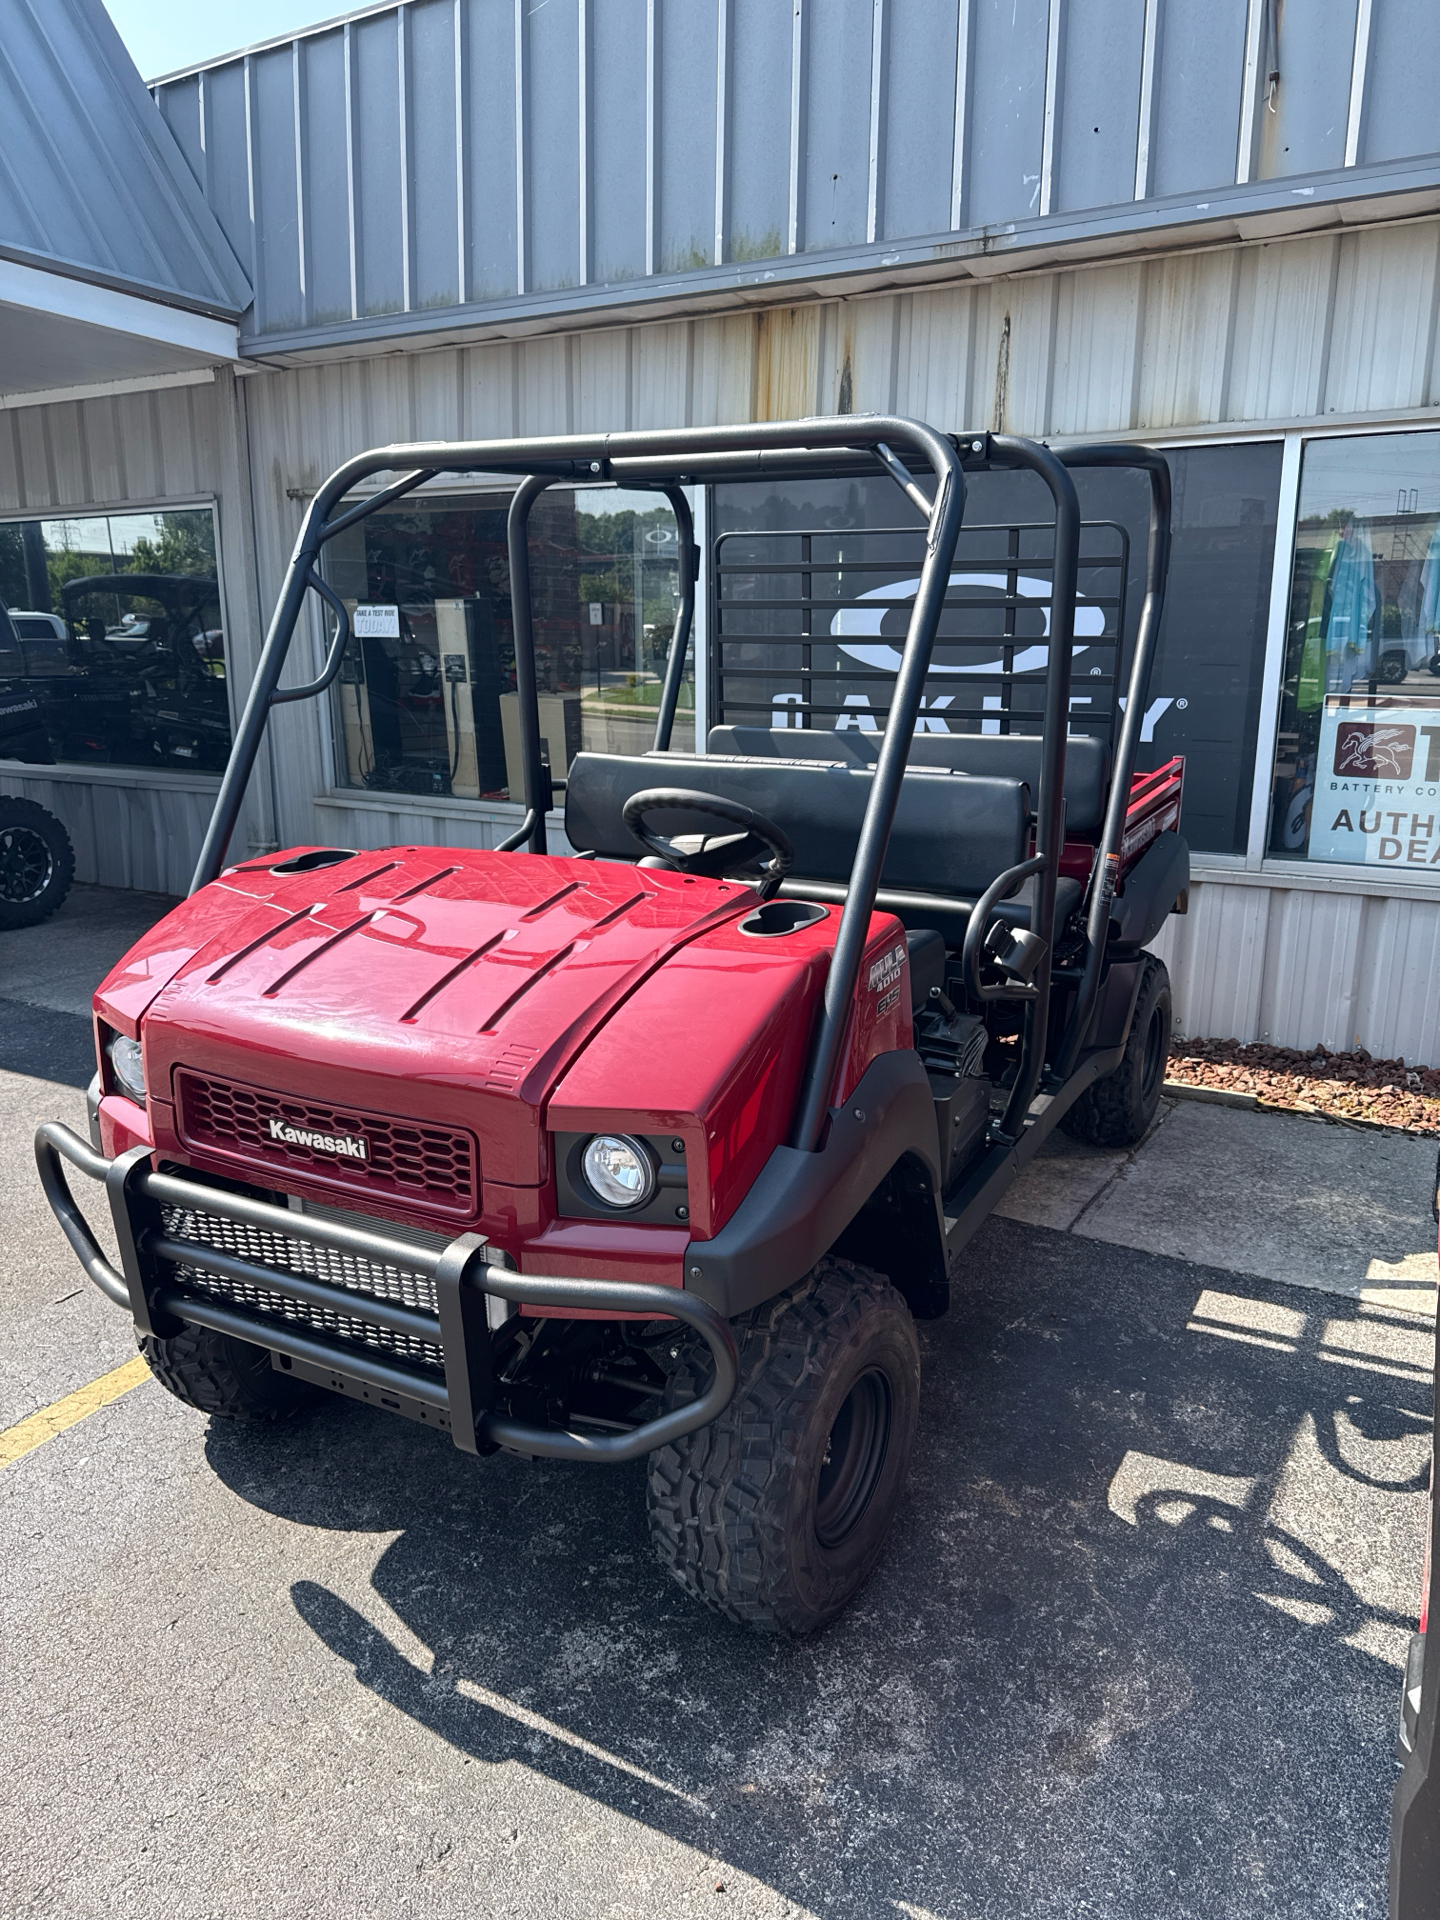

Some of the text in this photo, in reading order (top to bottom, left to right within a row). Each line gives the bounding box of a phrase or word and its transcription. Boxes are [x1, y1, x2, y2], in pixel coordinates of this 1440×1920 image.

[372, 609, 384, 617] TEST
[384, 609, 396, 617] RIDE
[0, 699, 38, 716] awasaki
[1330, 782, 1437, 797] BATTERY CO
[1330, 808, 1440, 838] AUTH
[868, 944, 908, 992] MULE
[876, 967, 901, 994] 4010
[269, 1119, 366, 1159] Kawasaki
